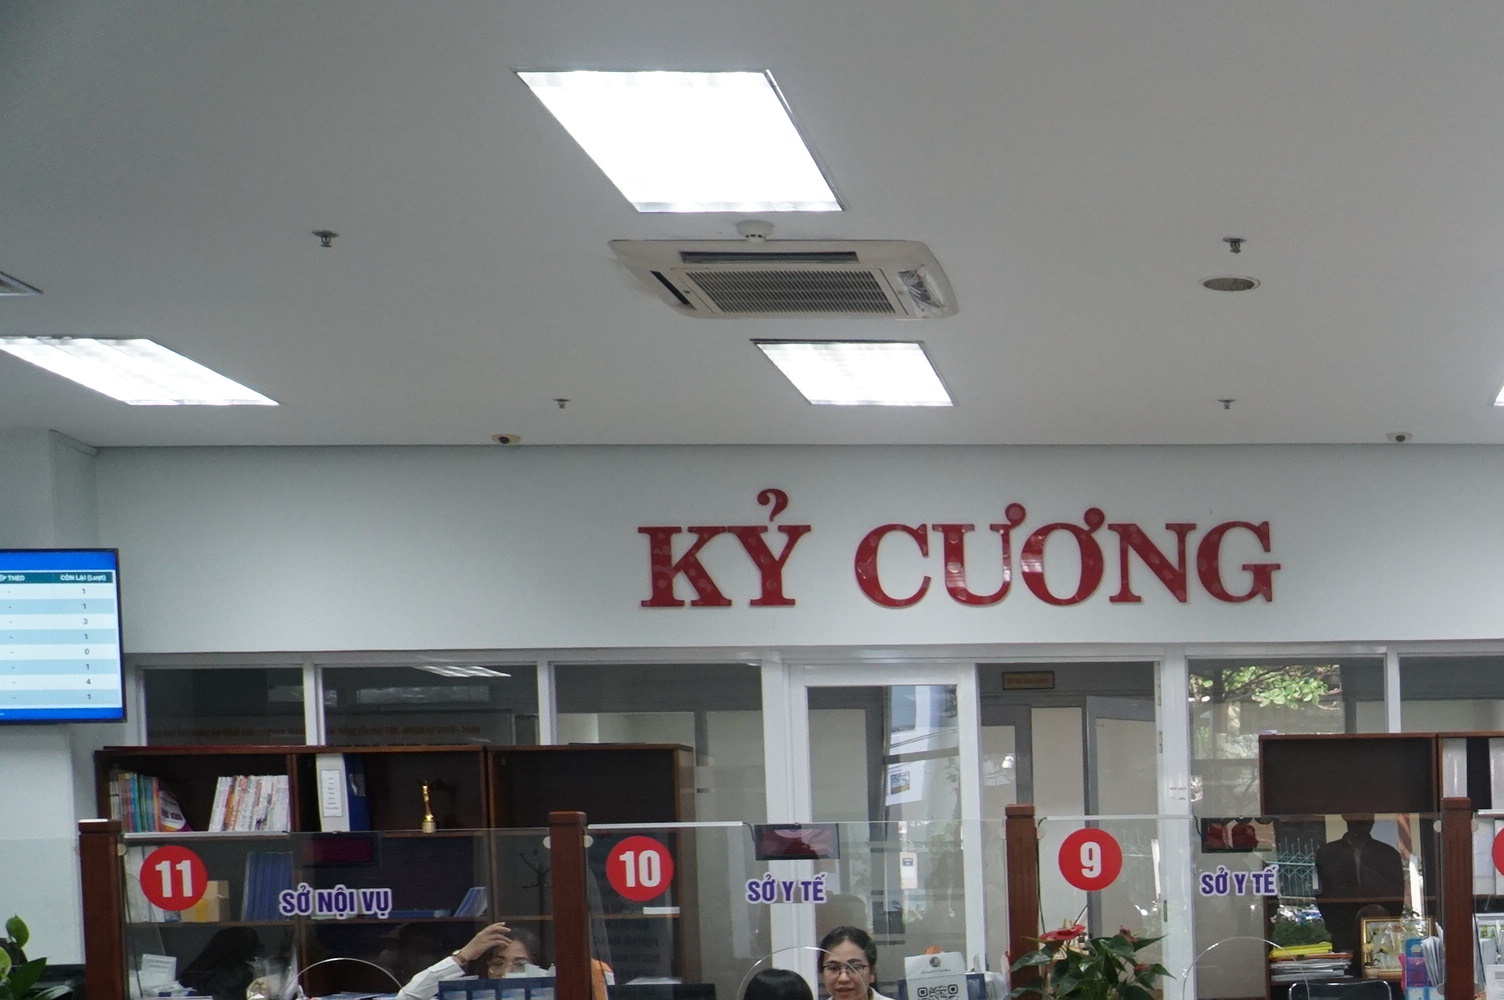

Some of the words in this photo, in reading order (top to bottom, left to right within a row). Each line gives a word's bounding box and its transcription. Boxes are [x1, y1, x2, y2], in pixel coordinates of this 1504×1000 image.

[637, 488, 811, 608] KỶ
[854, 502, 1281, 609] CƯƠNG
[155, 860, 193, 898] 11
[619, 850, 661, 888] 10
[1080, 841, 1102, 879] 9
[747, 874, 776, 902] SỞ
[781, 880, 795, 901] Y
[801, 873, 827, 901] TẾ
[1201, 867, 1228, 895] SỞ
[1234, 873, 1248, 894] Y
[1252, 865, 1278, 894] TẾ
[281, 884, 312, 914] SỞ
[317, 885, 356, 918] NỘI
[361, 890, 390, 917] VỤ
